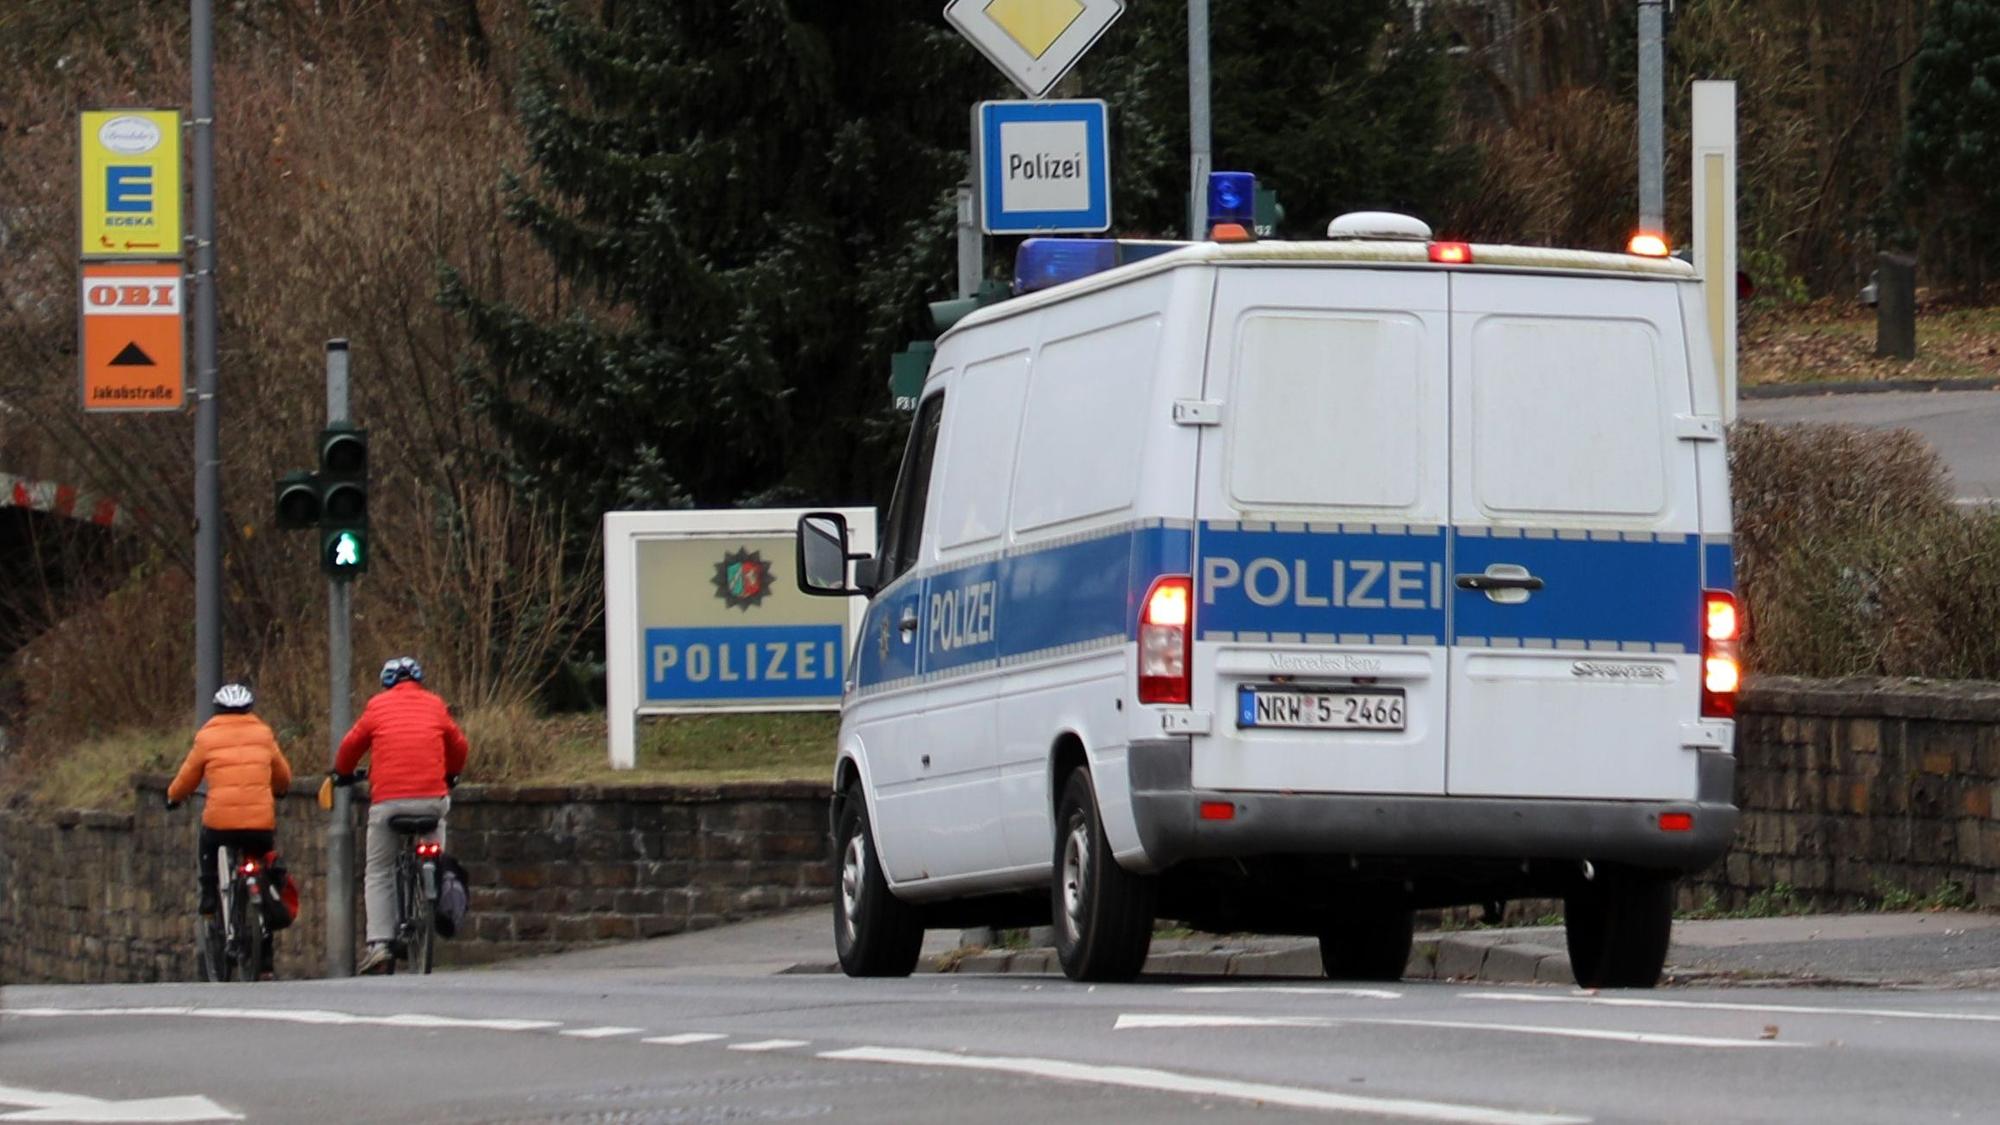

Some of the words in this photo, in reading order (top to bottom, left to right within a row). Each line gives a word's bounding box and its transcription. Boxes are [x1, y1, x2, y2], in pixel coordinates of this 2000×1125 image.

[1009, 152, 1082, 180] Polizei
[105, 216, 155, 227] EDEKA
[88, 284, 175, 306] OBI
[92, 384, 174, 400] Jakobstraße
[1202, 556, 1443, 610] POLIZEI
[929, 580, 997, 654] POLIZEI
[653, 641, 835, 683] POLIZEI
[1257, 694, 1301, 723] NRW
